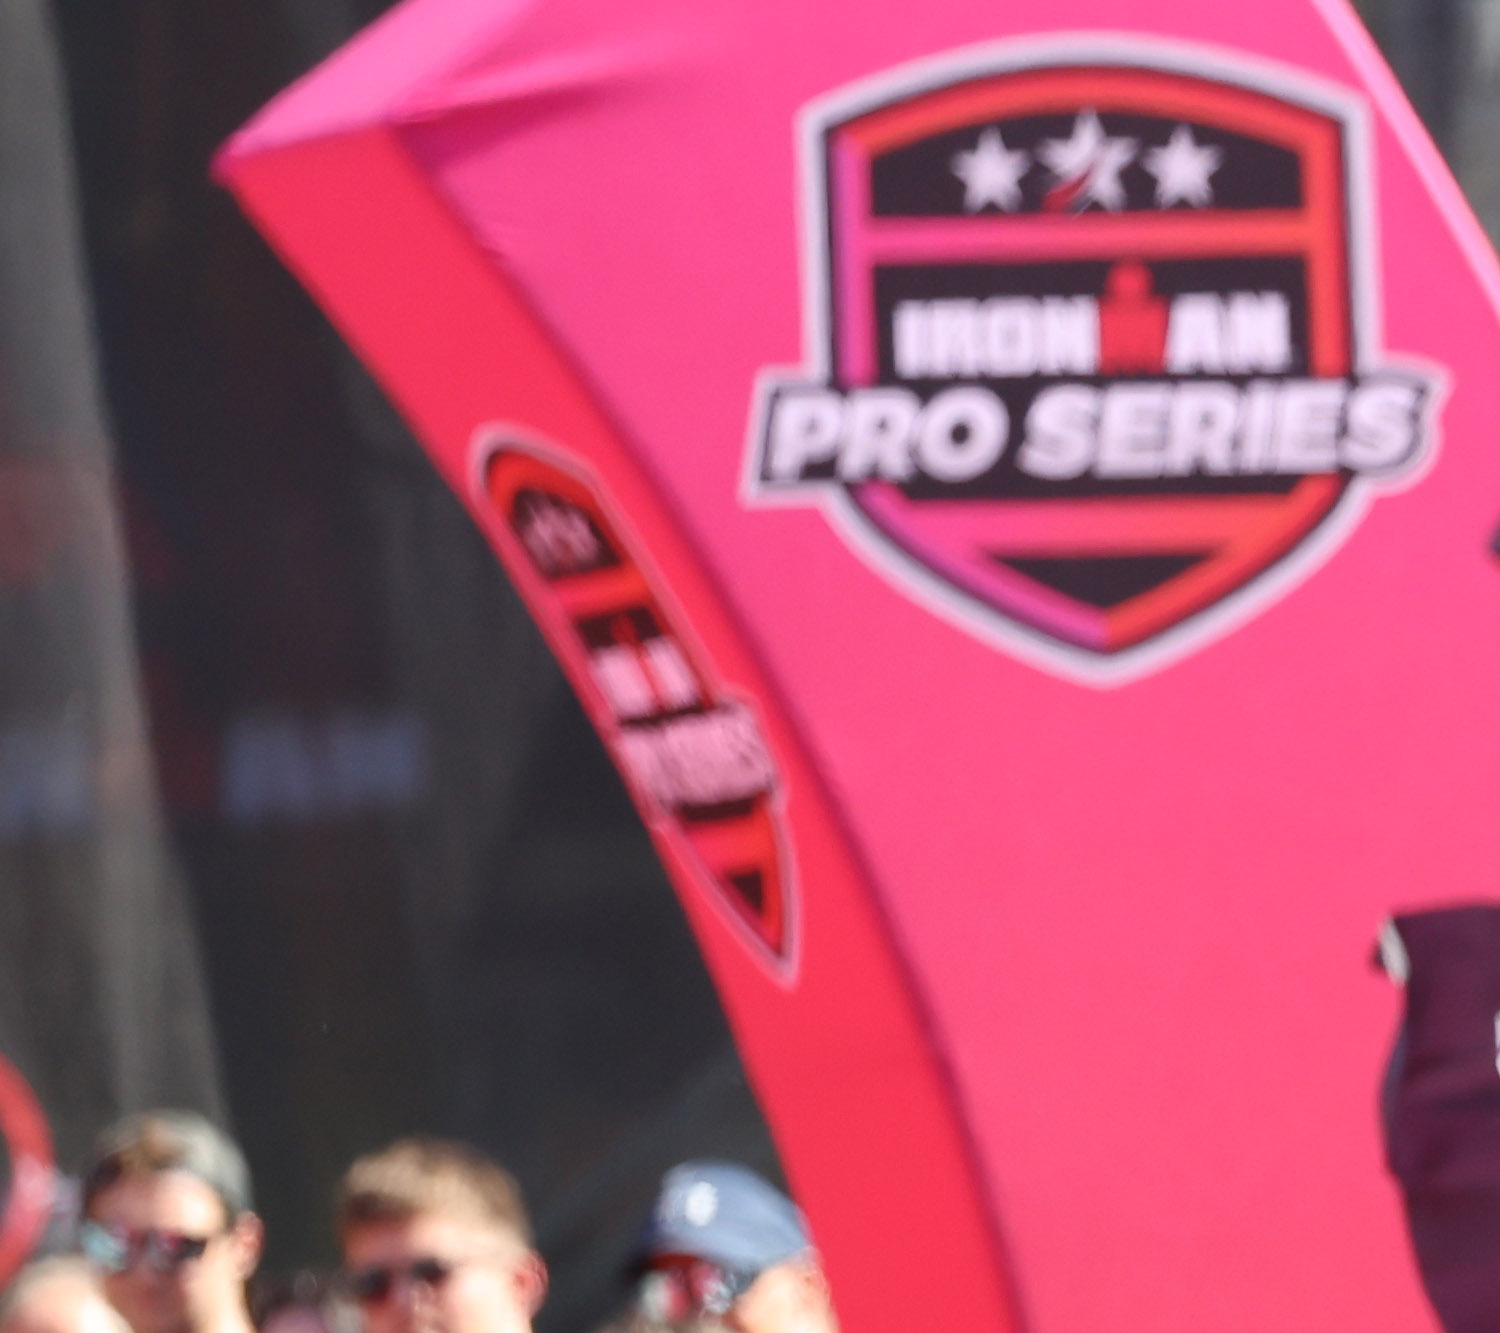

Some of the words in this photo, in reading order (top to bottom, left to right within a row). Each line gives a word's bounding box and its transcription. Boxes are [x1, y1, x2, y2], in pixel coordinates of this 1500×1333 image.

[891, 258, 1293, 377] IRONMAN
[764, 384, 1010, 484] PRO
[1014, 379, 1428, 481] SERIES
